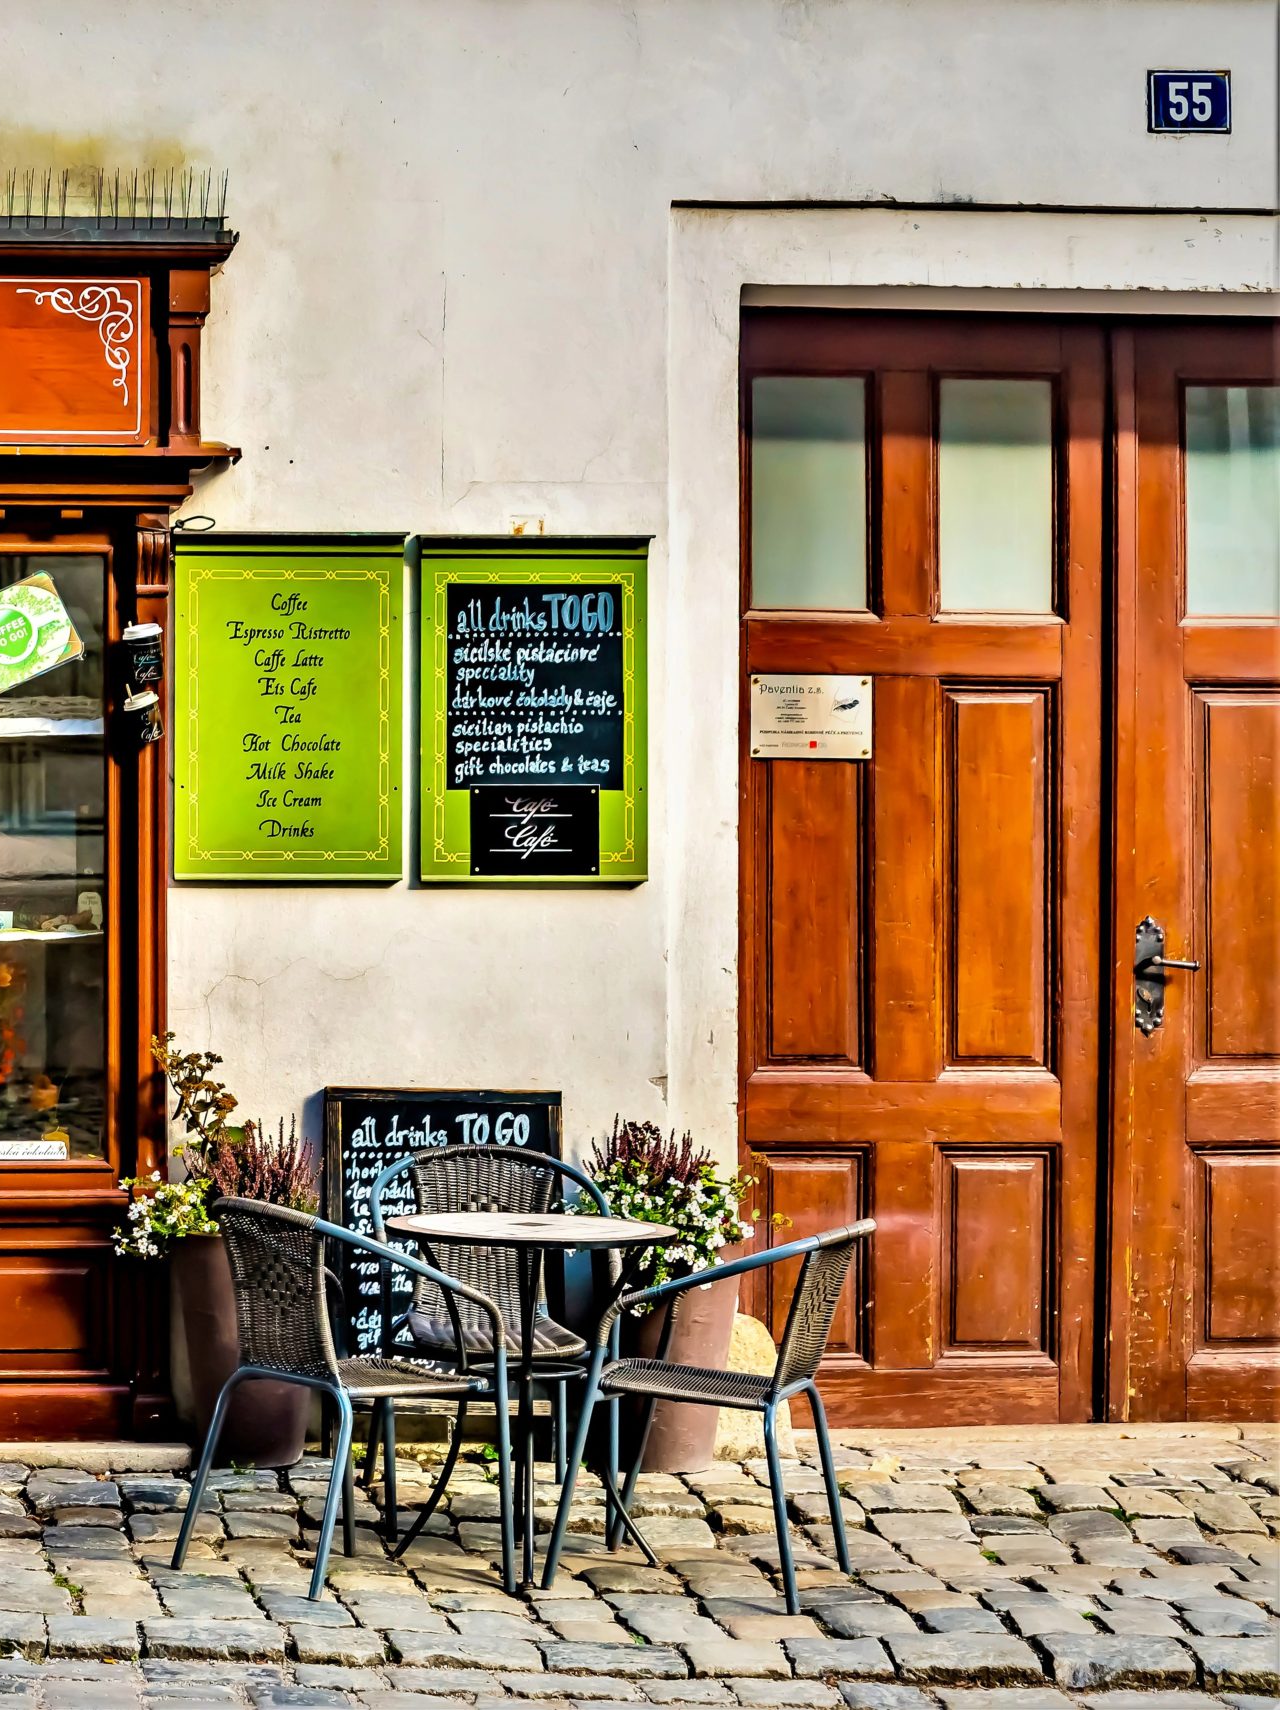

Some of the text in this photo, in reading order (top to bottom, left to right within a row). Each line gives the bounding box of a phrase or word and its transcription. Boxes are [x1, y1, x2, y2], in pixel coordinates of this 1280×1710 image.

[1169, 81, 1212, 122] 55
[270, 593, 308, 616] Coffee
[457, 599, 486, 633] all
[488, 596, 548, 632] drinks
[9, 627, 29, 642] GO!
[226, 621, 351, 645] Espresso Ristretto
[254, 649, 324, 673] Caffe Latte
[516, 641, 601, 666] pistáciové
[456, 662, 535, 687] speciality
[257, 677, 318, 701] Eis Cafe
[274, 705, 302, 725] Tea
[452, 717, 585, 737] sicilian pistachio
[242, 733, 341, 753] Hot Chocolate
[246, 762, 335, 781] Milk Shake
[455, 757, 484, 783] gift
[561, 757, 573, 773] &
[577, 755, 610, 774] teas
[256, 790, 322, 808] Ice Cream
[258, 819, 315, 838] Drinks
[505, 825, 558, 860] Café
[352, 1116, 381, 1148] all
[385, 1115, 448, 1147] drinks
